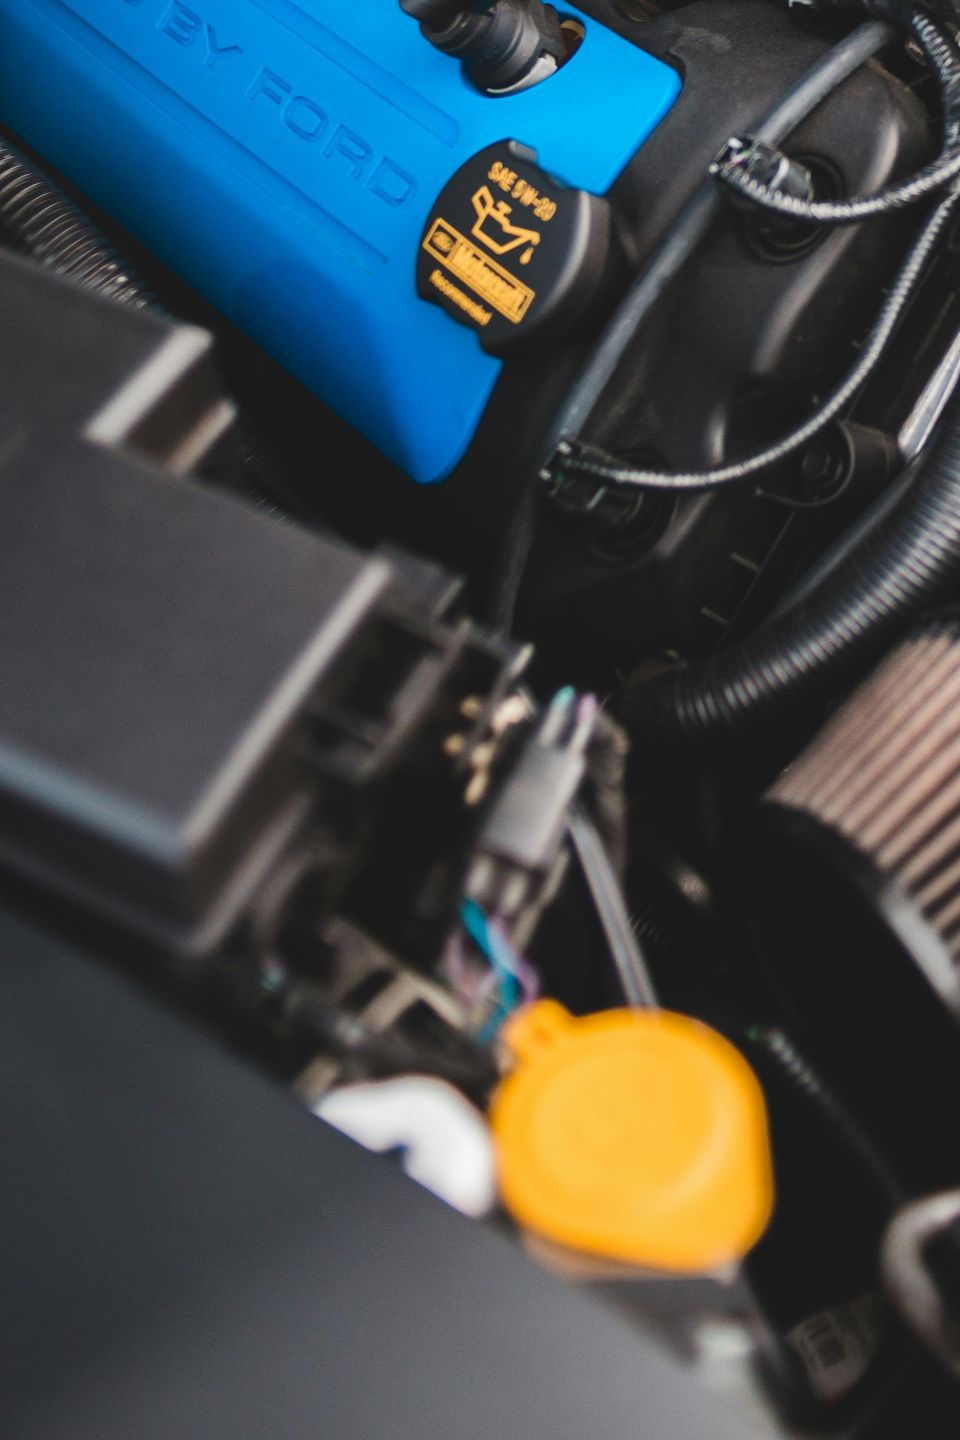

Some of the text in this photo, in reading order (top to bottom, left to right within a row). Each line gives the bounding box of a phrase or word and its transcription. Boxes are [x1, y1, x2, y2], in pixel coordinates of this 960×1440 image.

[245, 66, 419, 207] FORD
[488, 161, 518, 192] SAE
[429, 269, 492, 326] Recommended
